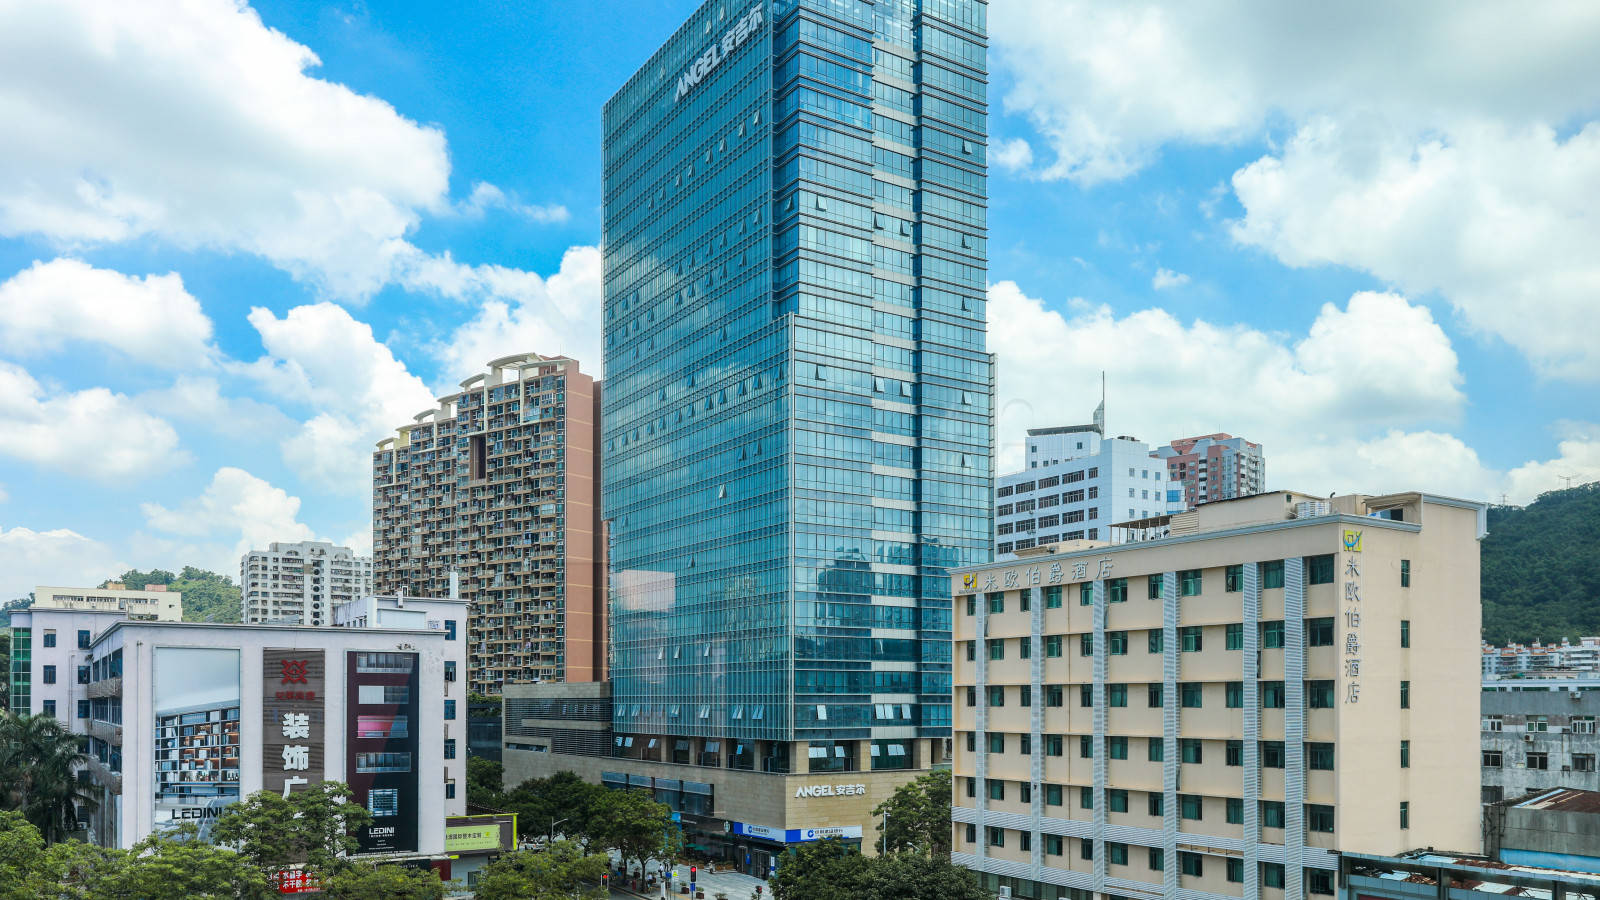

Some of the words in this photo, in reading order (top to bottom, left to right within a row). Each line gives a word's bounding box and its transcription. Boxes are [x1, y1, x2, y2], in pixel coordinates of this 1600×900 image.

[675, 43, 721, 103] ANGEL
[721, 2, 763, 60] 安吉尔
[984, 556, 1113, 591] 米欧伯爵酒店
[1344, 556, 1361, 704] 米欧伯爵酒店
[281, 712, 310, 812] 装饰广
[795, 785, 834, 798] ANGEL
[836, 783, 866, 796] 安吉尔
[171, 807, 222, 819] LEDINI
[368, 826, 395, 835] LEDINI
